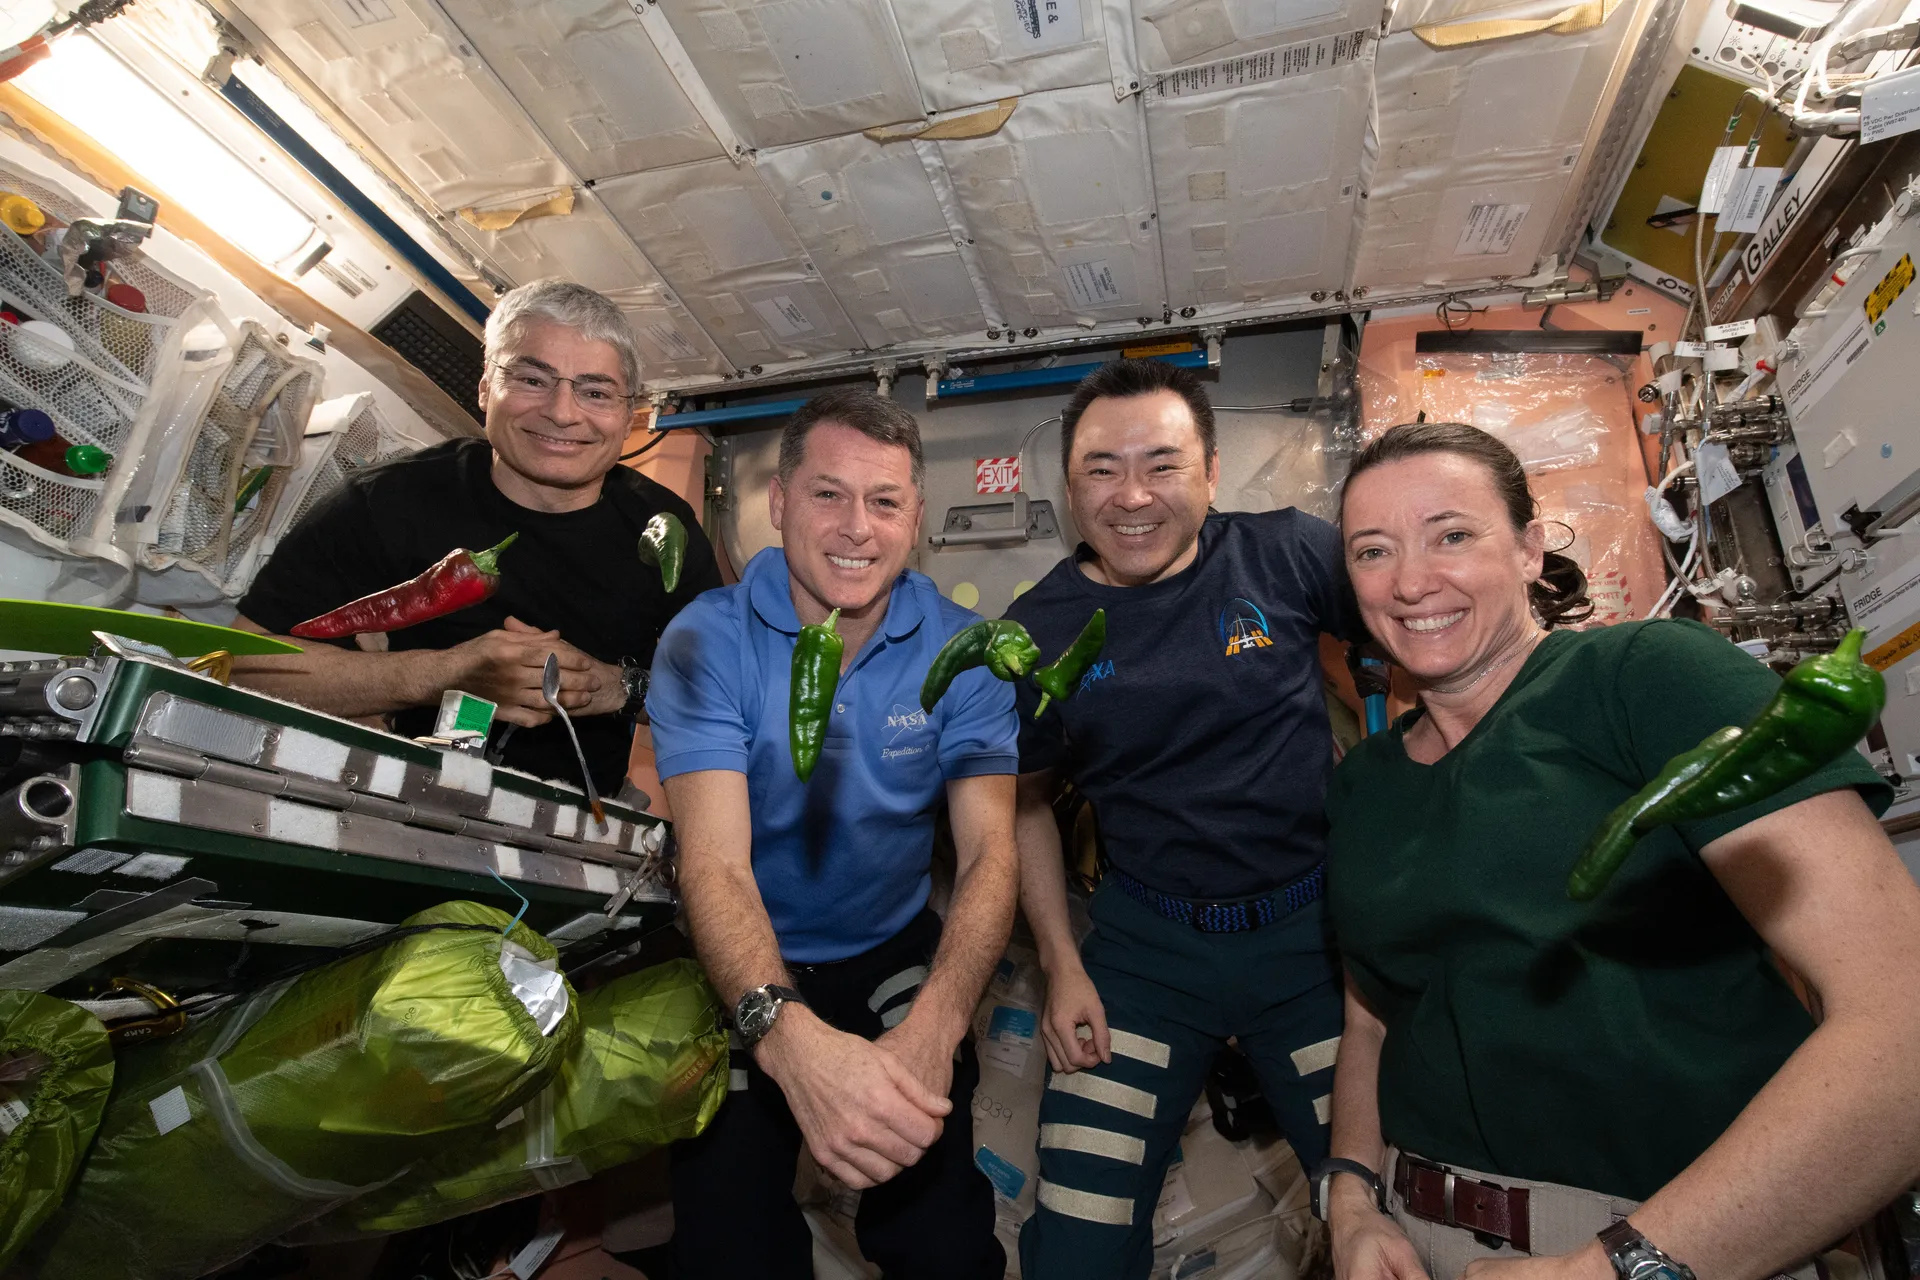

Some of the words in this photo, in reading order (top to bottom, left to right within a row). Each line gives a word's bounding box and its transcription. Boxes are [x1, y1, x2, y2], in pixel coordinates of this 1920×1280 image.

[1747, 188, 1801, 275] GALLEY
[1787, 369, 1812, 398] FRIDGE
[983, 466, 1012, 485] EXIT
[1853, 587, 1882, 611] FRIDGE
[887, 713, 927, 727] NASA
[881, 747, 923, 760] Expedition
[124, 1027, 152, 1038] CAMP
